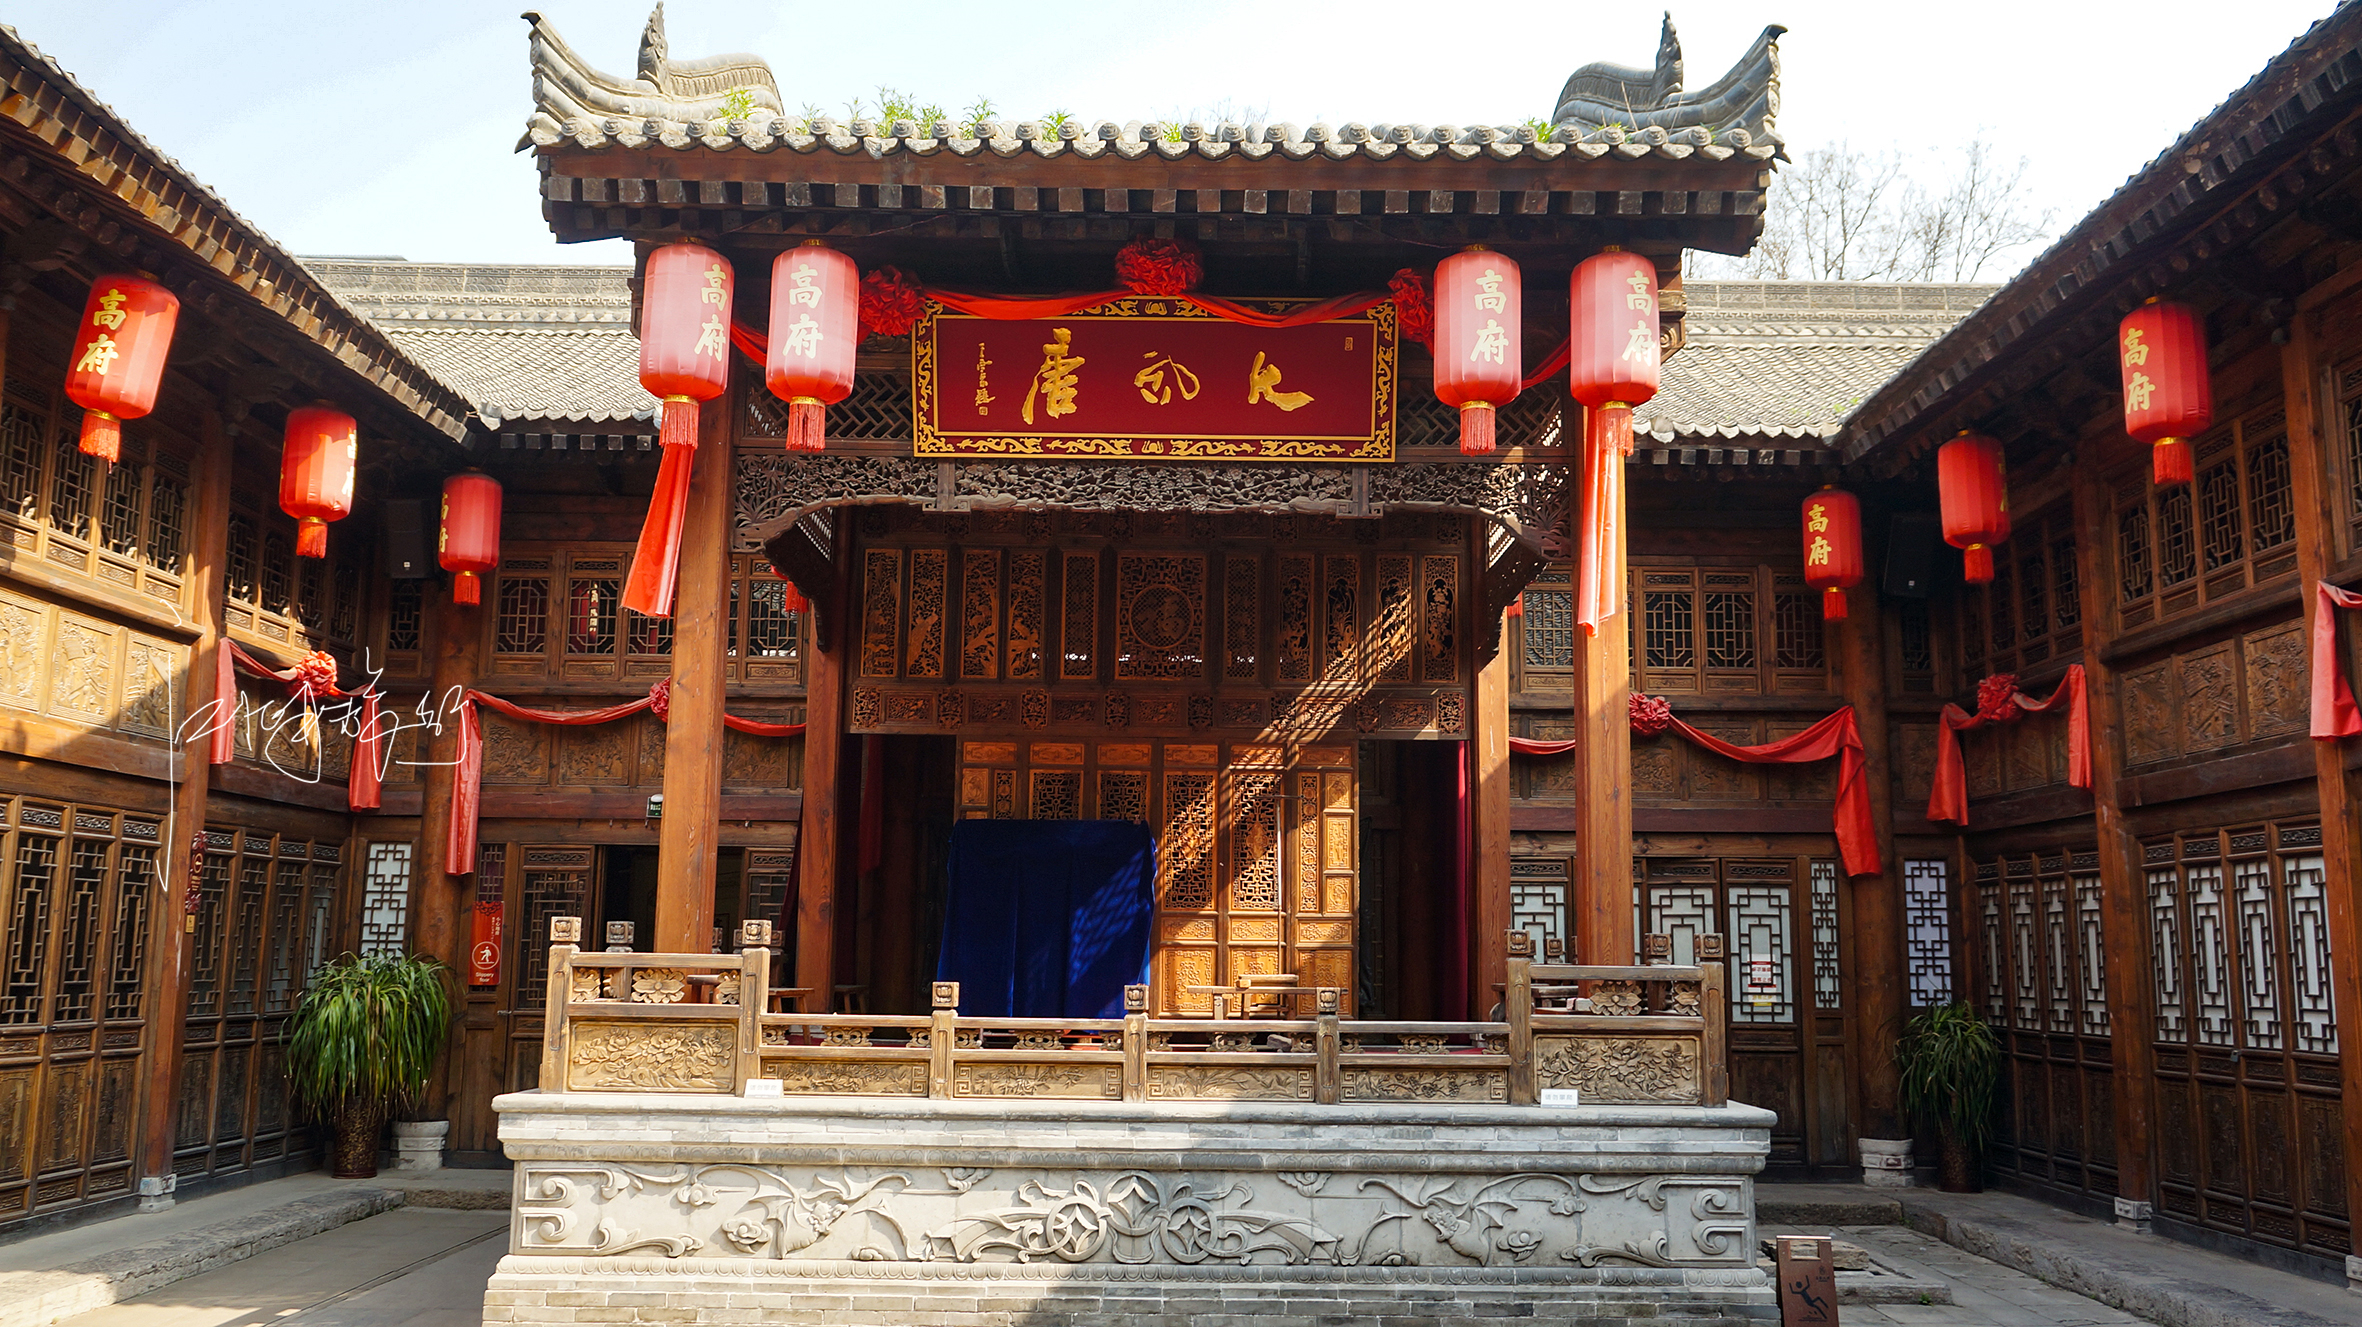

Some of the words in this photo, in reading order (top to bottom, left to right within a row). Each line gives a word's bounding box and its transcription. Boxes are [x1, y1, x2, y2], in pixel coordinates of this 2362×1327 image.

[76, 288, 127, 376] 高府
[694, 263, 729, 363] 高府
[782, 263, 824, 360] 高府
[1470, 268, 1510, 365] 高府
[1622, 270, 1659, 367] 高府
[2123, 327, 2156, 415] 高府
[1808, 503, 1832, 567] 高府
